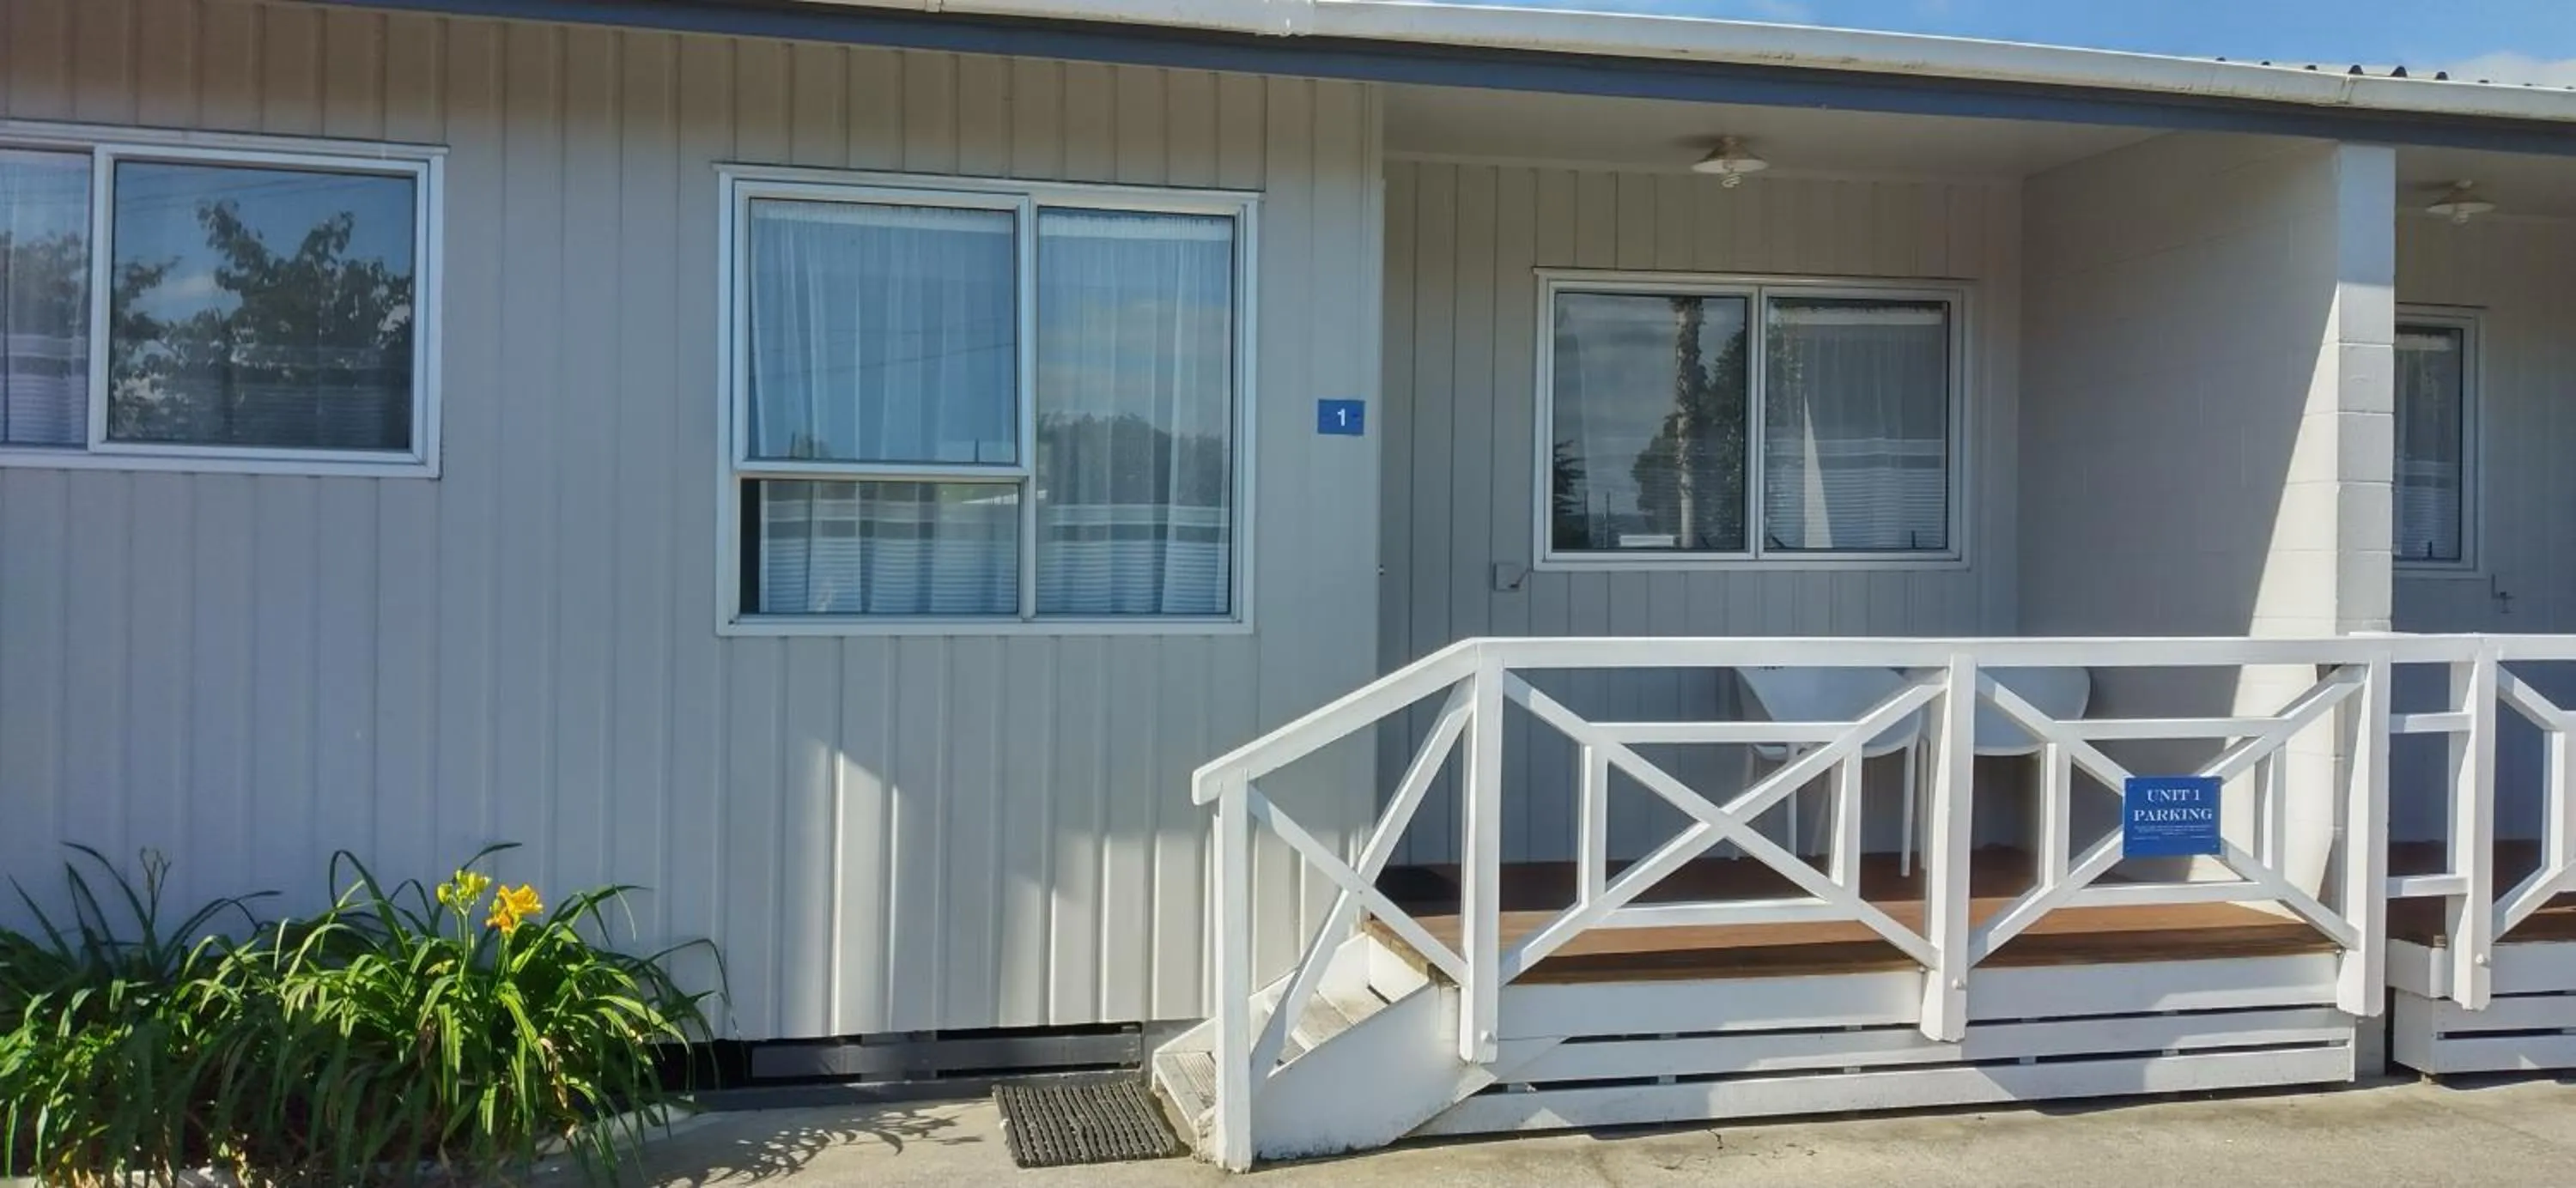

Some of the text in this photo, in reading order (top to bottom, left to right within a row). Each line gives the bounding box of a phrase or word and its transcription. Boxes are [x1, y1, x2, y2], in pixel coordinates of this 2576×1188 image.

[1337, 408, 1346, 427] 1
[2147, 789, 2200, 802] UNIT 1
[2134, 808, 2213, 821] PARKING
